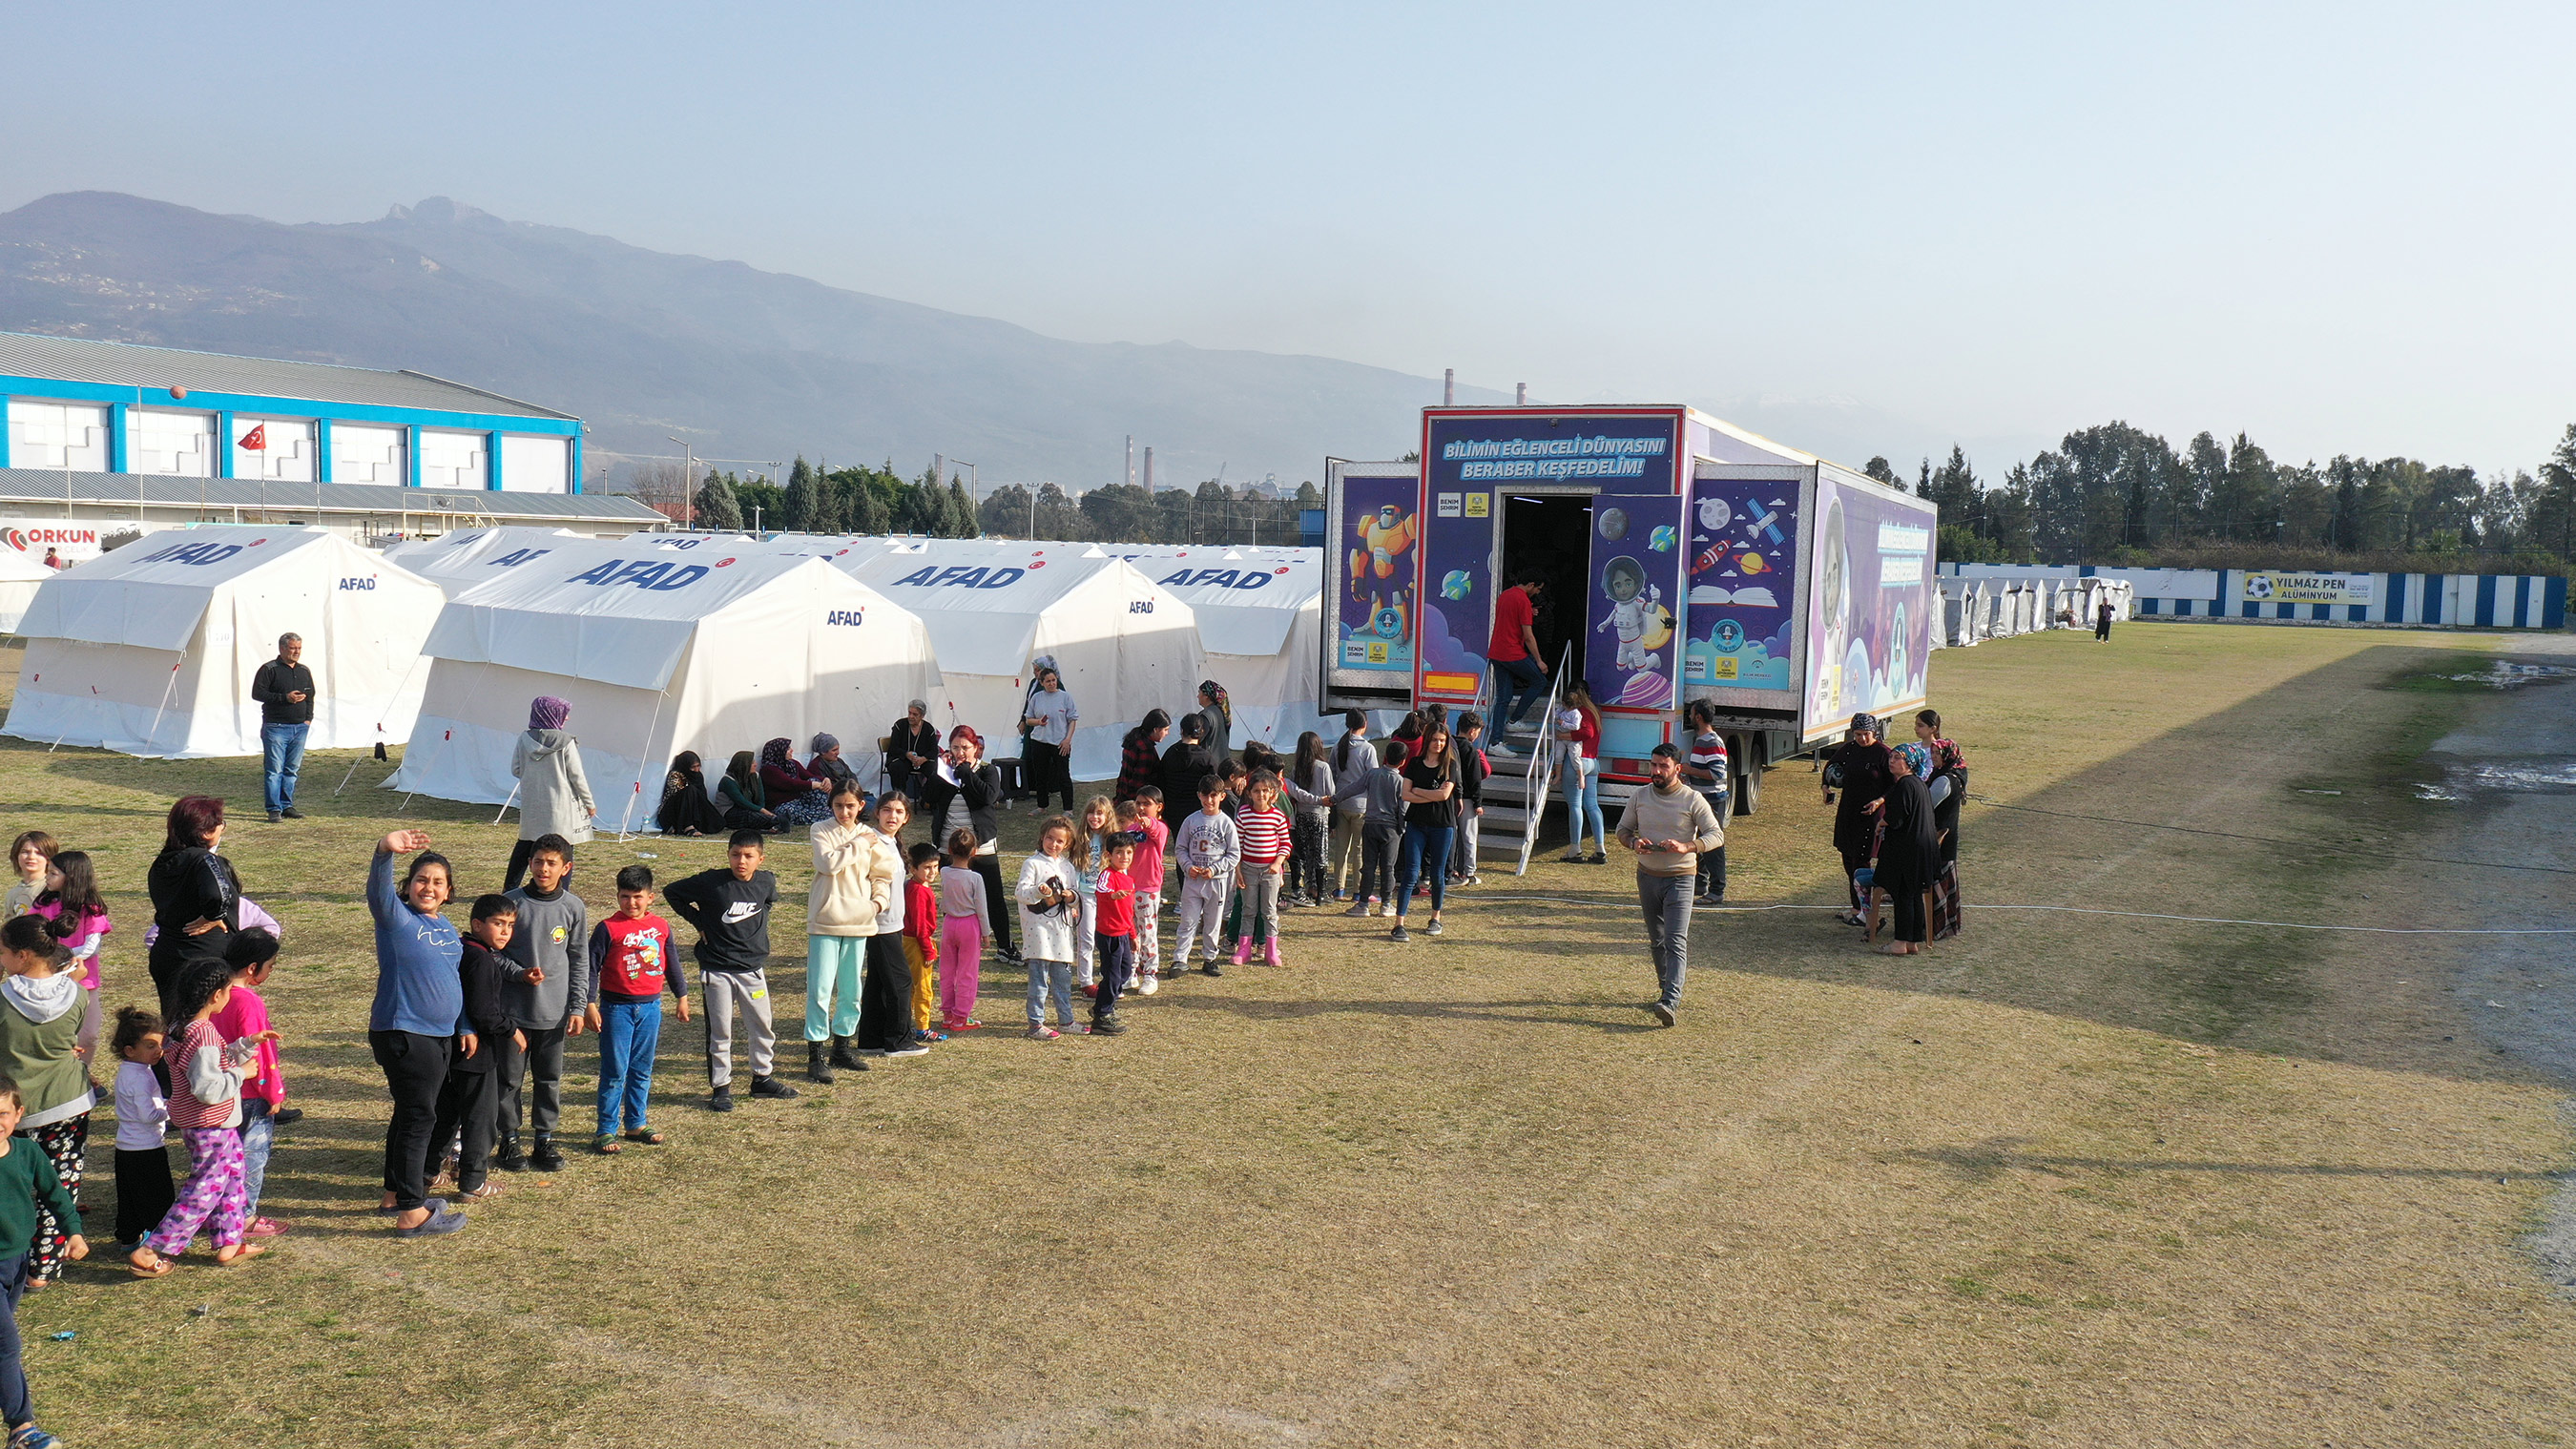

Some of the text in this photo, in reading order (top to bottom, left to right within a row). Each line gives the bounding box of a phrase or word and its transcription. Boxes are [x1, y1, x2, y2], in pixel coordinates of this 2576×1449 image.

[1445, 438, 1665, 458] BİLİMİN EĞLENCELİ DÜNYASINI
[1464, 457, 1644, 480] BERABER KEŞFEDELİM!
[29, 529, 95, 544] ORKUN
[131, 542, 243, 566] AFAD
[487, 549, 552, 567] AF
[564, 559, 710, 591] AFAD
[890, 566, 1026, 590] AFAD
[1156, 569, 1273, 590] AFAD
[339, 578, 376, 590] AFAD
[2322, 579, 2345, 590] PEN
[2281, 589, 2337, 600] ALÜMİNYUM
[1129, 601, 1153, 613] AFAD
[827, 611, 862, 627] AFAD
[1199, 839, 1209, 852] C
[728, 901, 758, 915] NIKE
